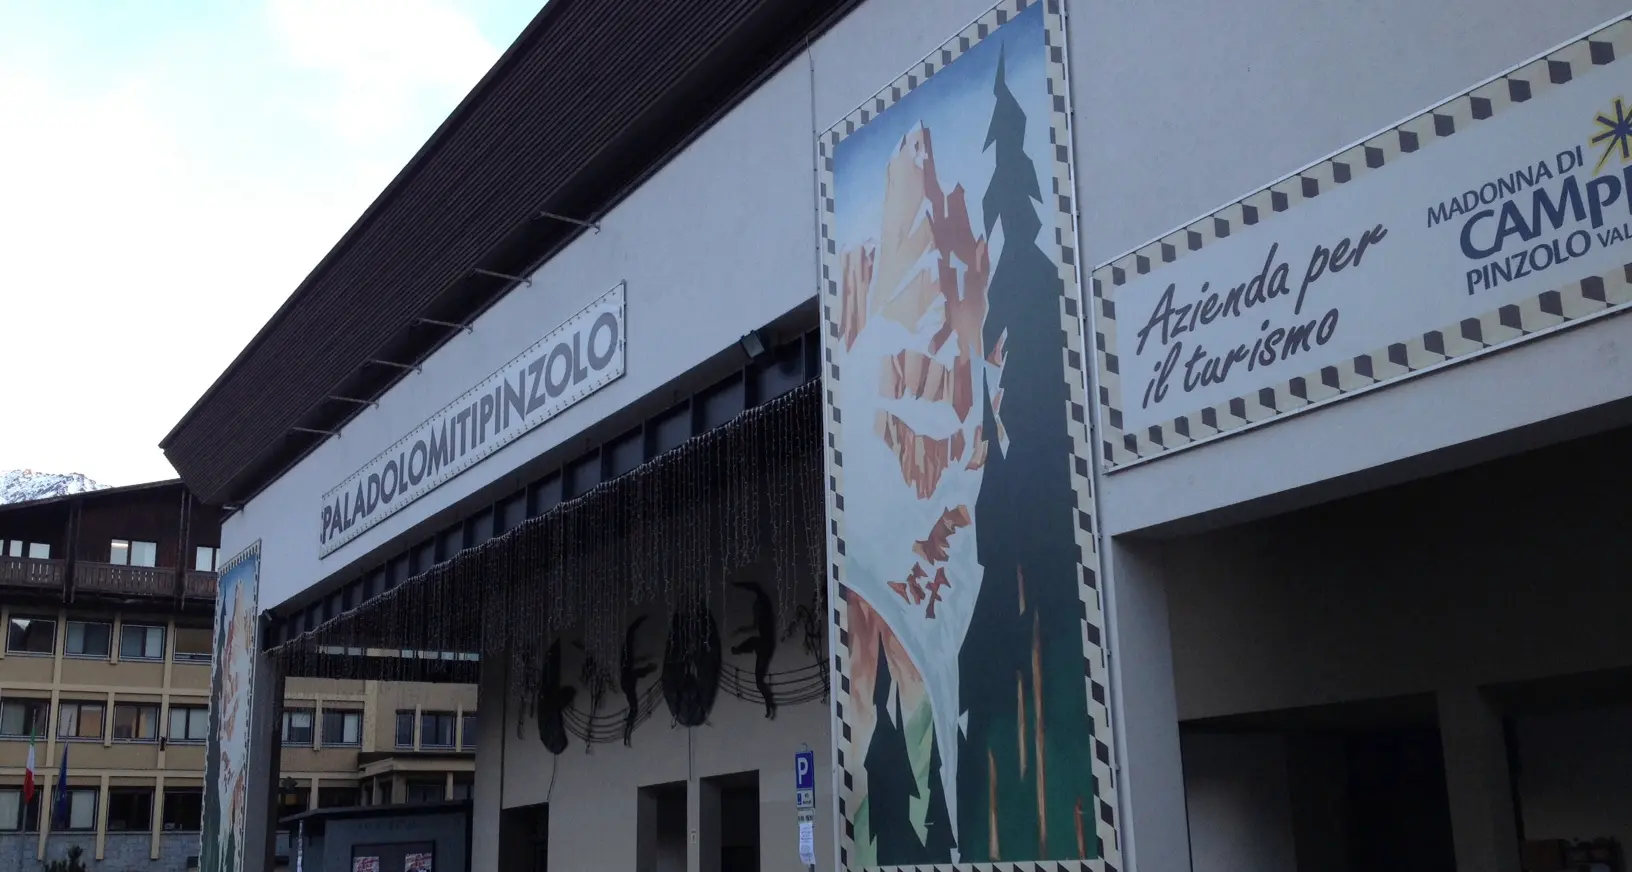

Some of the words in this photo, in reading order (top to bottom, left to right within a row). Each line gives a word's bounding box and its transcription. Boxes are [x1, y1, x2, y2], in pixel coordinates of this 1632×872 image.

[1427, 160, 1553, 228] MADONNA
[1556, 145, 1583, 175] DI
[1136, 242, 1290, 356] Azienda
[1294, 223, 1388, 315] per
[1466, 230, 1592, 295] PINZOLO
[1142, 341, 1182, 410] il
[1183, 308, 1339, 392] turismo
[321, 312, 619, 545] PALADOLOMITIPINZOLO
[797, 757, 808, 785] P
